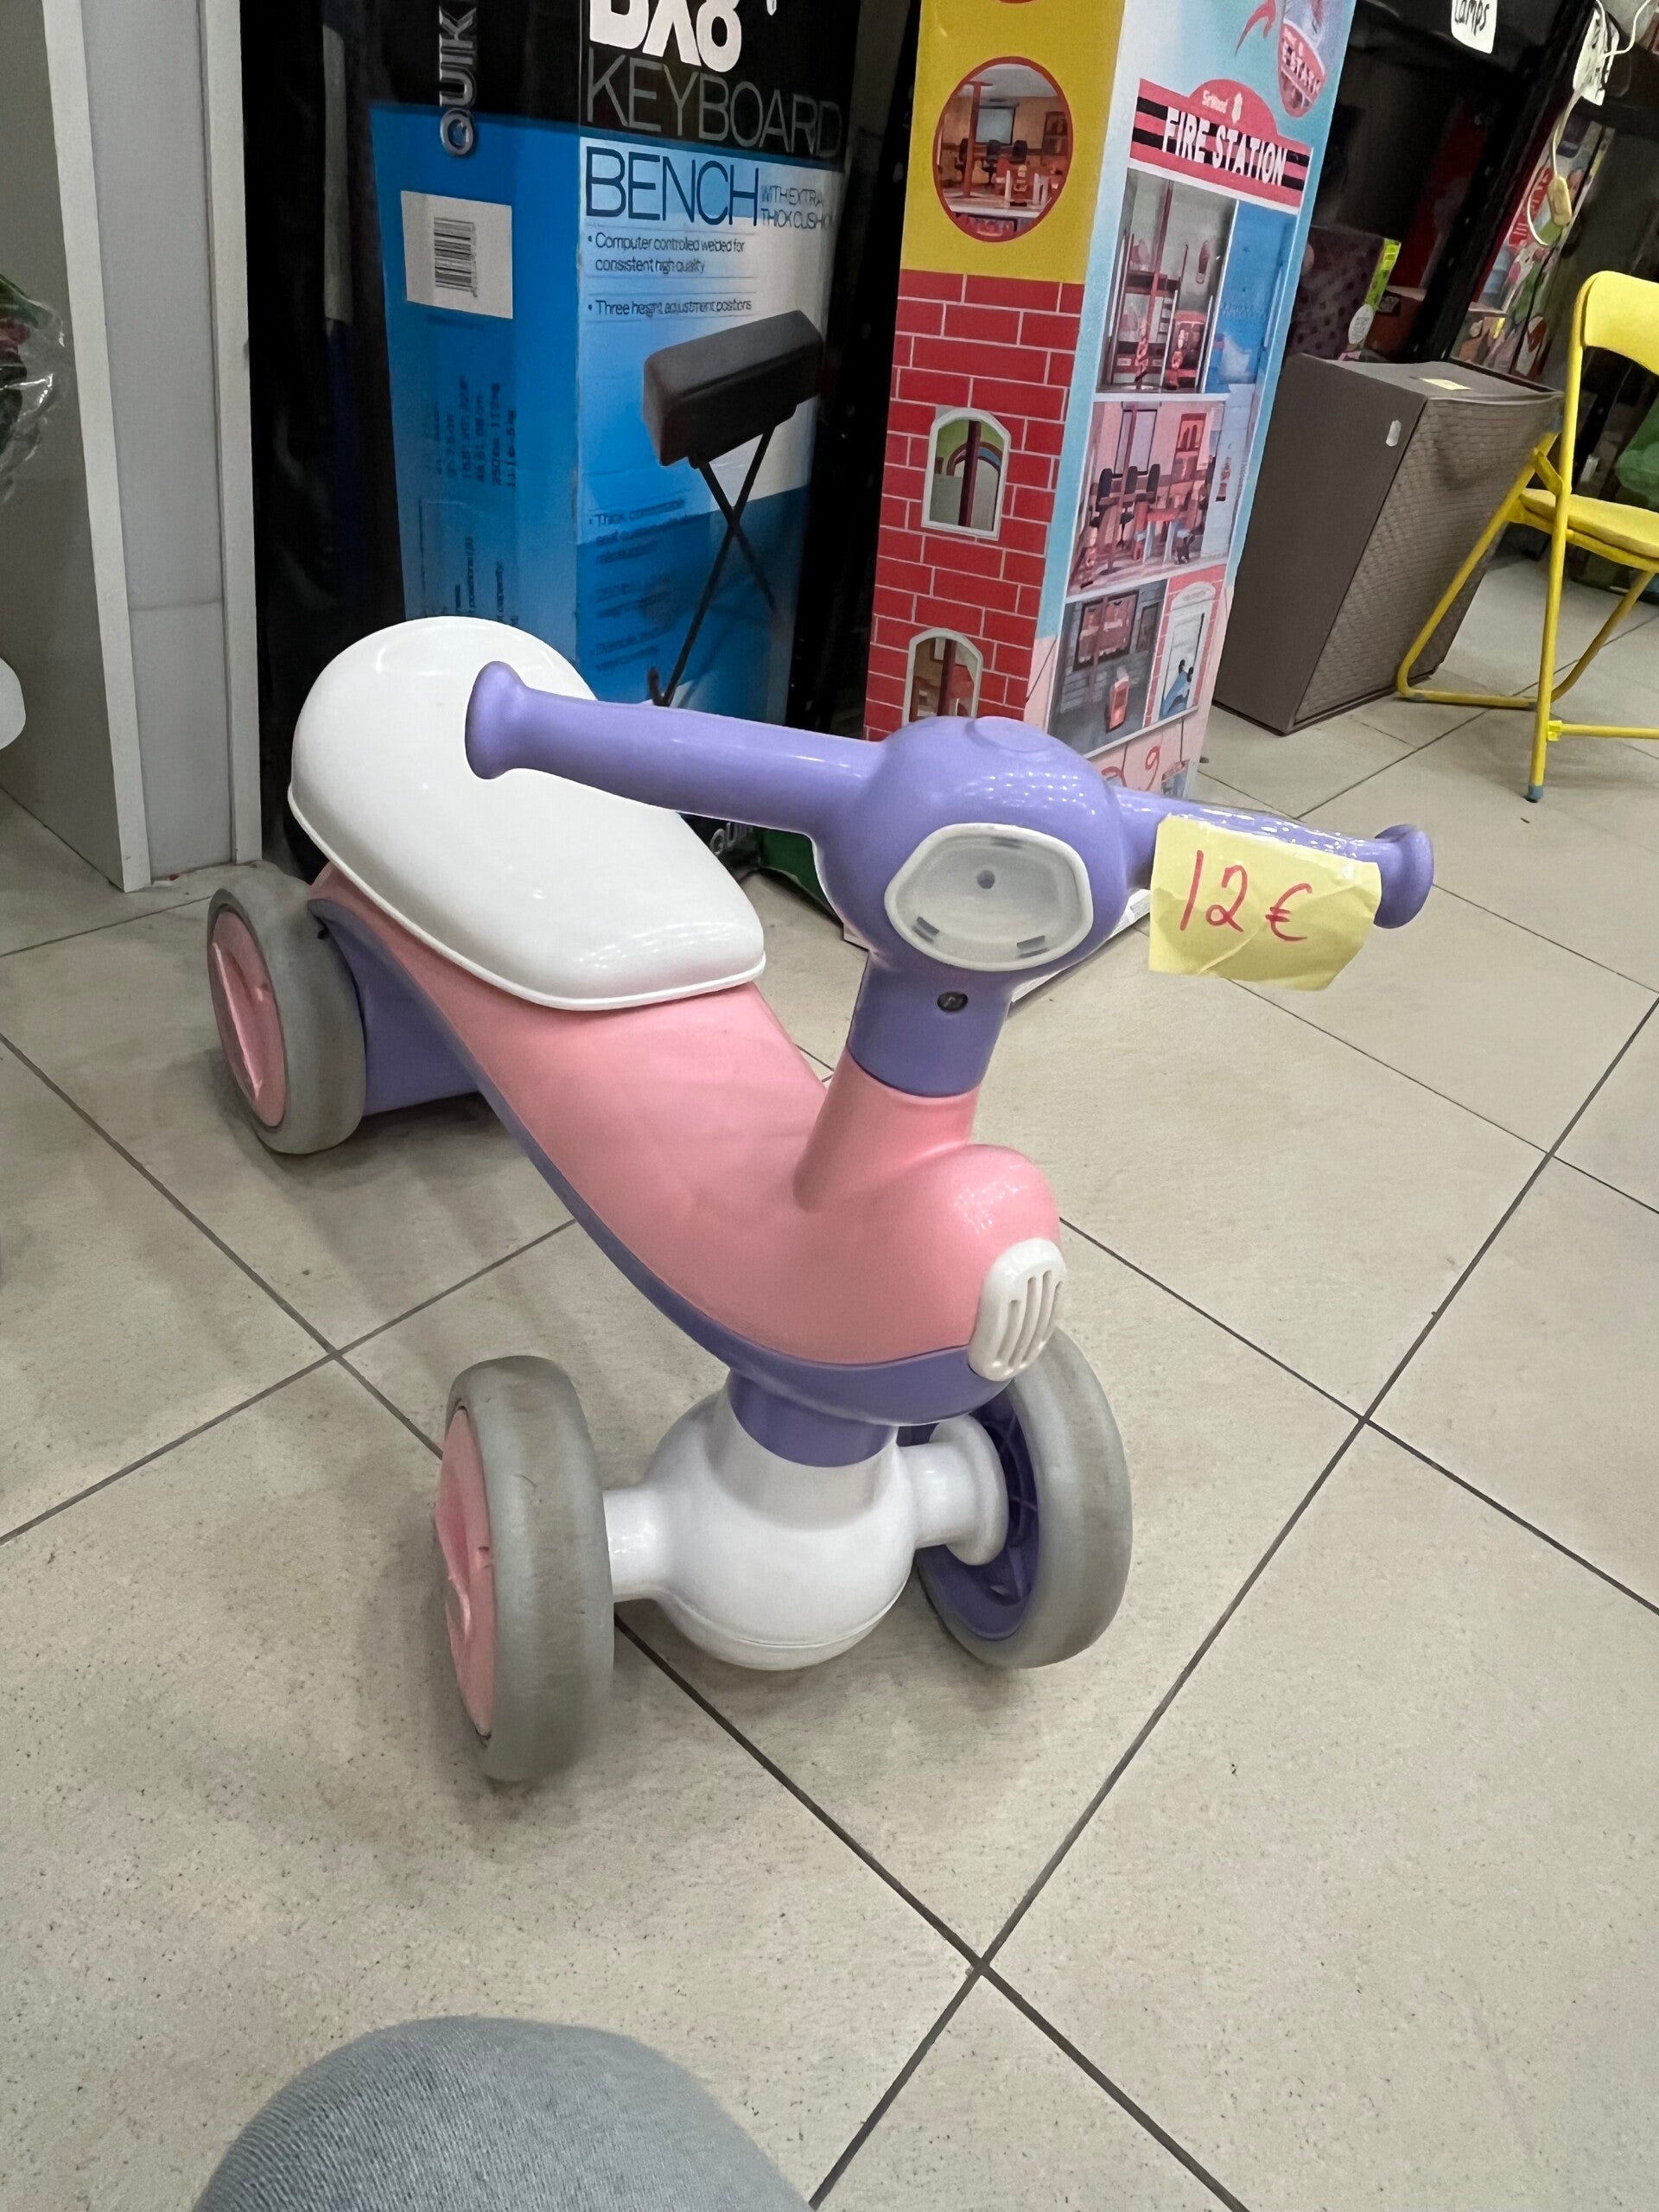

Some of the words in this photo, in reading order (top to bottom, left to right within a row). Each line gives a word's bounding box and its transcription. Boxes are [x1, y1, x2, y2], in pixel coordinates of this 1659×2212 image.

[439, 5, 477, 158] QUIK
[587, 47, 843, 157] KEYBOARD
[586, 146, 759, 226] BENCH
[1162, 106, 1211, 163] FIRE
[1211, 124, 1287, 187] STATION
[595, 232, 652, 251] Computer
[595, 257, 653, 272] consistent
[595, 299, 630, 315] Three
[1179, 849, 1249, 933] 12
[1265, 882, 1313, 942] €
